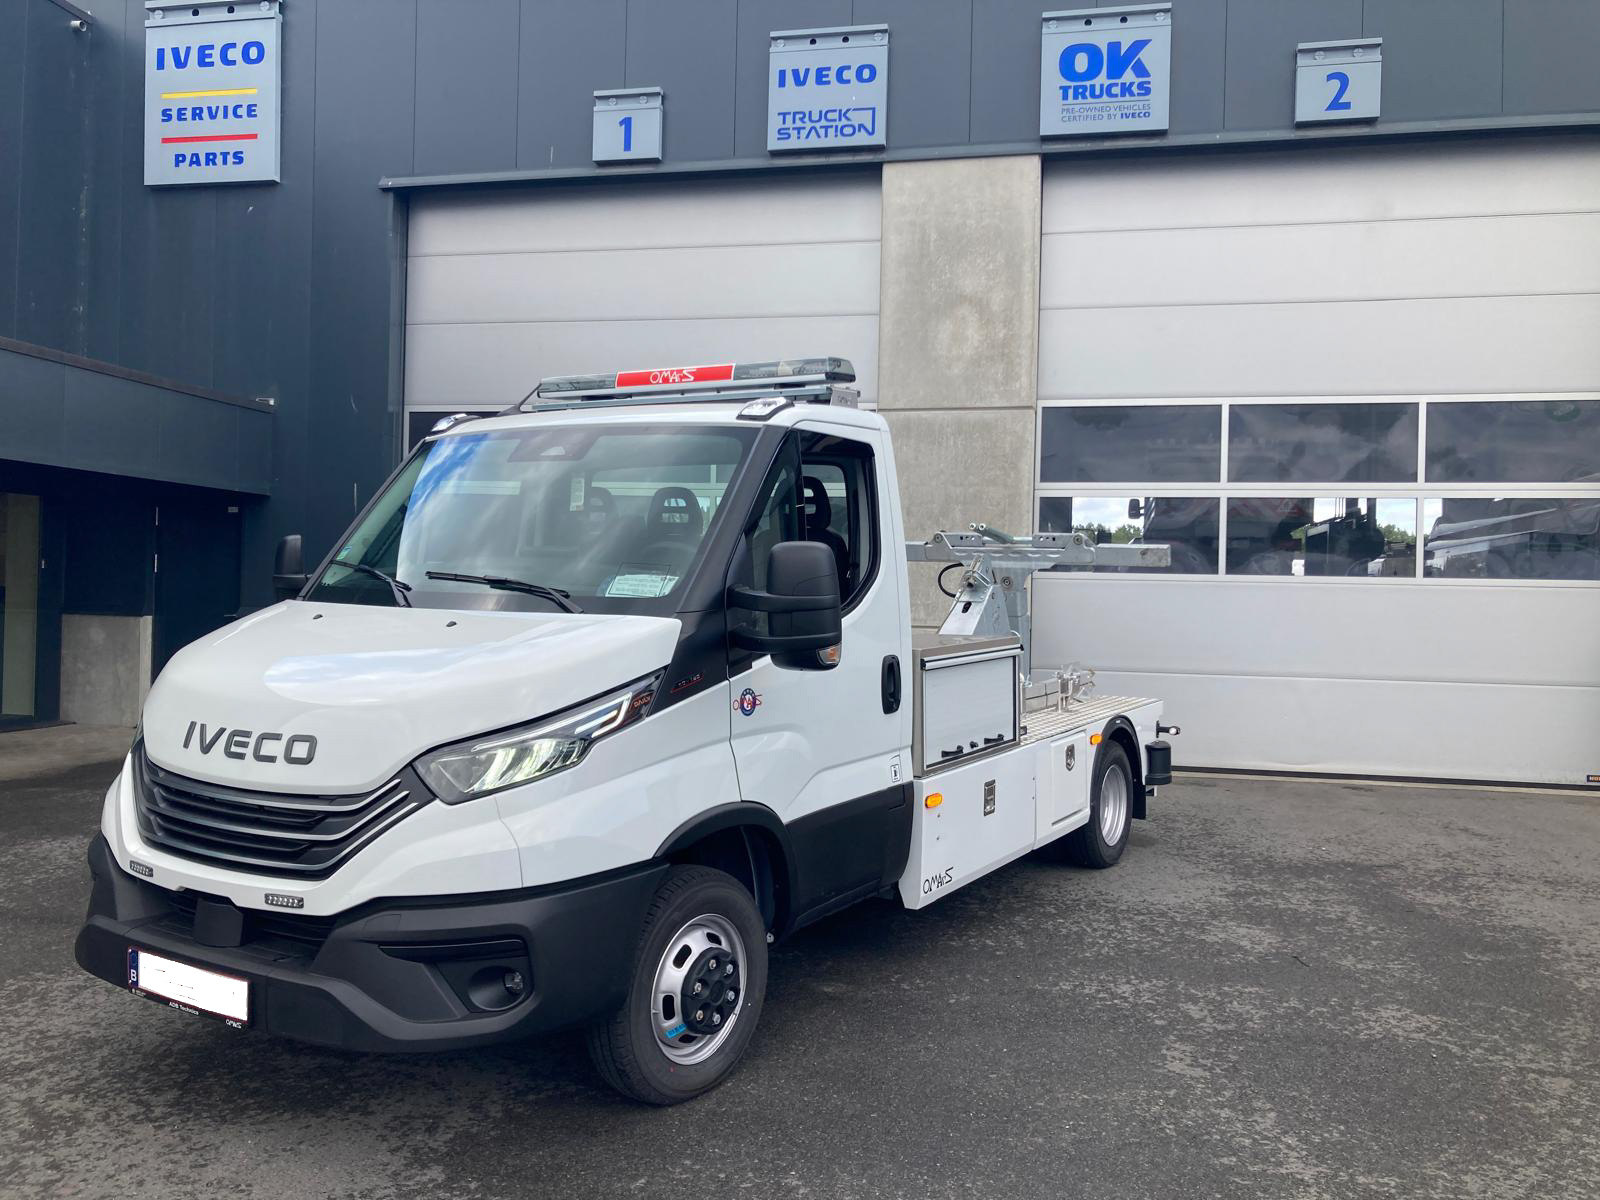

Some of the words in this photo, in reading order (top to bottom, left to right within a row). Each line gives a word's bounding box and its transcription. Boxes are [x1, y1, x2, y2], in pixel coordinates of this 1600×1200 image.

[156, 41, 265, 70] IVECO
[1059, 39, 1152, 83] OK
[778, 64, 877, 88] IVECO
[1059, 81, 1152, 101] TRUCKS
[1324, 72, 1352, 111] 2
[161, 104, 258, 122] SERVICE
[777, 108, 853, 125] TRUCK
[1061, 105, 1111, 115] PRE-OWNED
[1113, 103, 1151, 112] VEHICLES
[1061, 113, 1104, 123] CERTIFIED
[1107, 113, 1119, 121] BY
[1120, 111, 1151, 120] IVECO
[618, 116, 633, 152] 1
[777, 121, 876, 140] STATION
[174, 151, 245, 168] PARTS
[183, 720, 318, 766] IVECO
[130, 969, 137, 981] B
